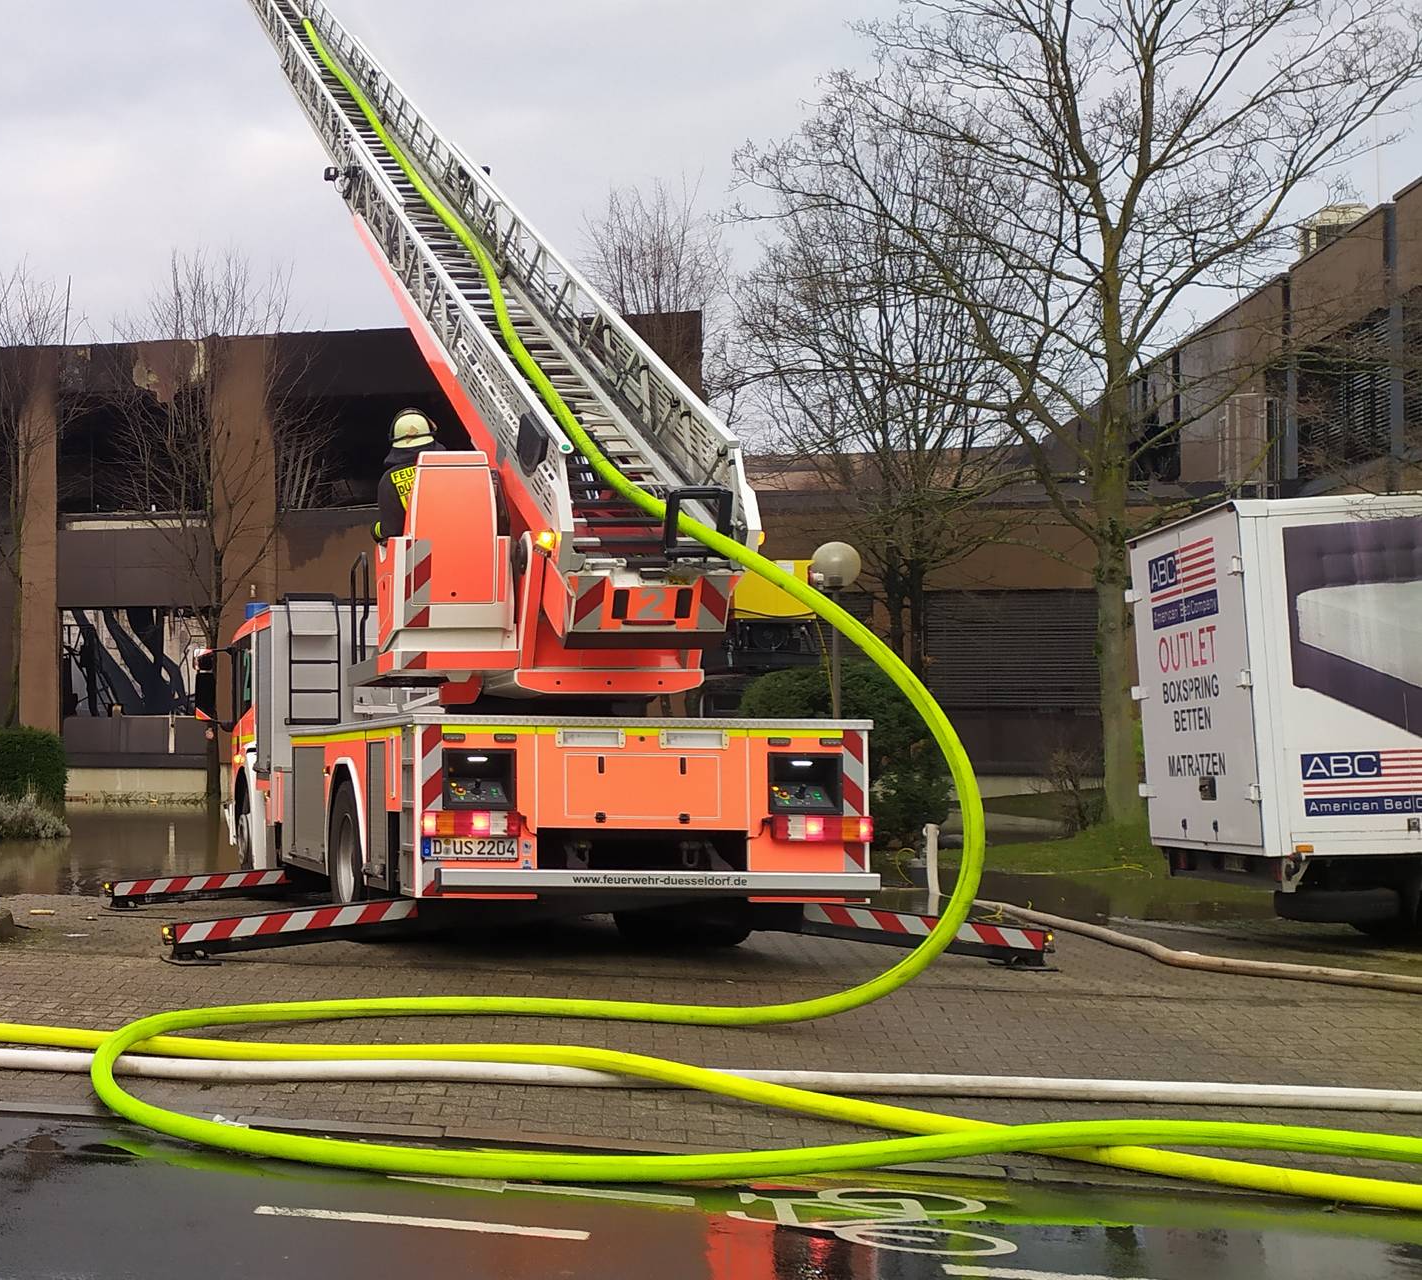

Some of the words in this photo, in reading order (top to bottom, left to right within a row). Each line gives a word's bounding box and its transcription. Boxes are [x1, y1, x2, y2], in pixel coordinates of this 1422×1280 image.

[1151, 556, 1176, 590] ABC
[636, 588, 666, 619] 2
[1159, 625, 1216, 672] OUTLET
[243, 648, 251, 702] 2
[1162, 674, 1219, 704] BOXSPRING
[1174, 706, 1212, 732] BETTEN
[1168, 752, 1226, 777] MATRATZEN
[1305, 754, 1378, 778] ABC
[1309, 800, 1379, 813] American
[1384, 798, 1412, 810] Bed
[433, 839, 442, 855] D
[453, 840, 474, 856] US
[477, 840, 516, 856] 2204
[572, 874, 748, 887] www.feuerwehr-duesseldorf.de
